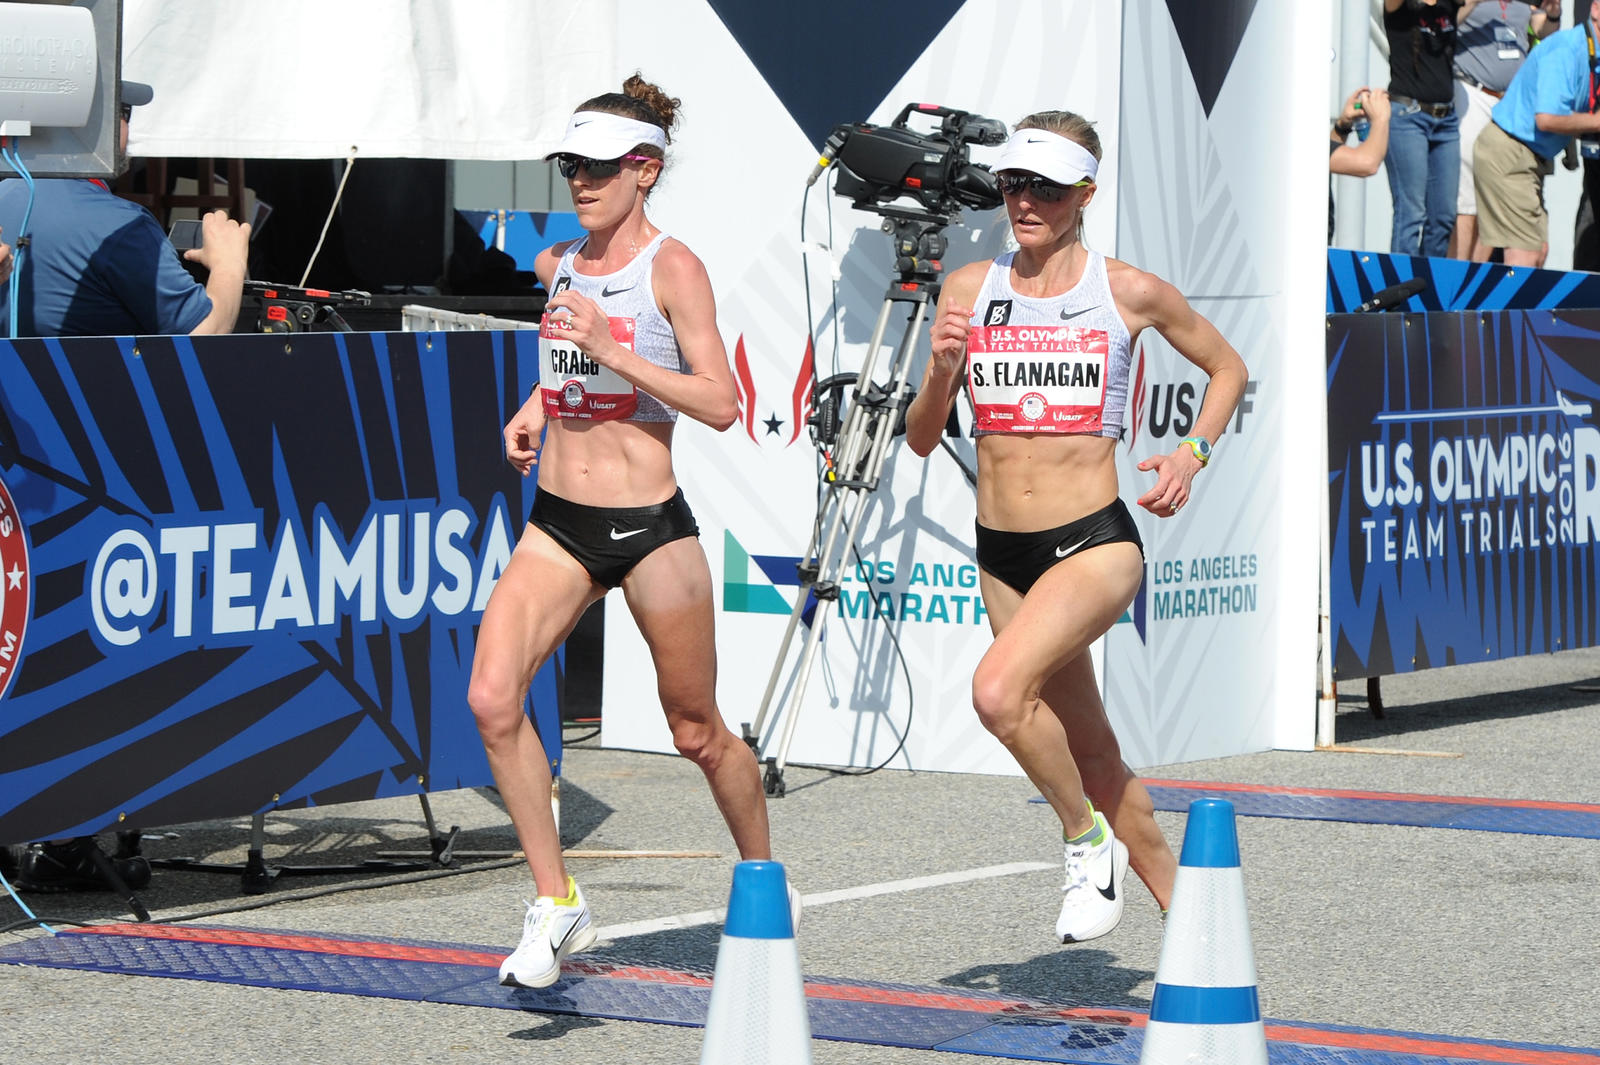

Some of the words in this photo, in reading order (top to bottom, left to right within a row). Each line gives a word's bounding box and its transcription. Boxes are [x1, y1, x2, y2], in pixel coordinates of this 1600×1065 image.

[990, 342, 1026, 351] TEAM
[1033, 342, 1081, 351] TRIALS
[991, 330, 1016, 342] U.S.
[1018, 330, 1082, 342] OLYMPIC
[551, 349, 600, 376] CRAGG
[973, 362, 990, 387] S.
[994, 362, 1100, 388] FLANAGAN
[1149, 381, 1258, 439] USF
[1362, 443, 1423, 507] U.S.
[1430, 433, 1557, 502] OLYMPIC
[1559, 432, 1574, 543] 2016
[1362, 514, 1444, 563] TEAM
[1461, 505, 1557, 554] TRIALS
[91, 505, 512, 646] @TEAMUSA
[909, 562, 977, 588] ANG
[1154, 560, 1183, 585] LOS
[1190, 554, 1257, 582] ANGELES
[838, 590, 988, 625] MARATH
[1154, 584, 1257, 621] MARATHON
